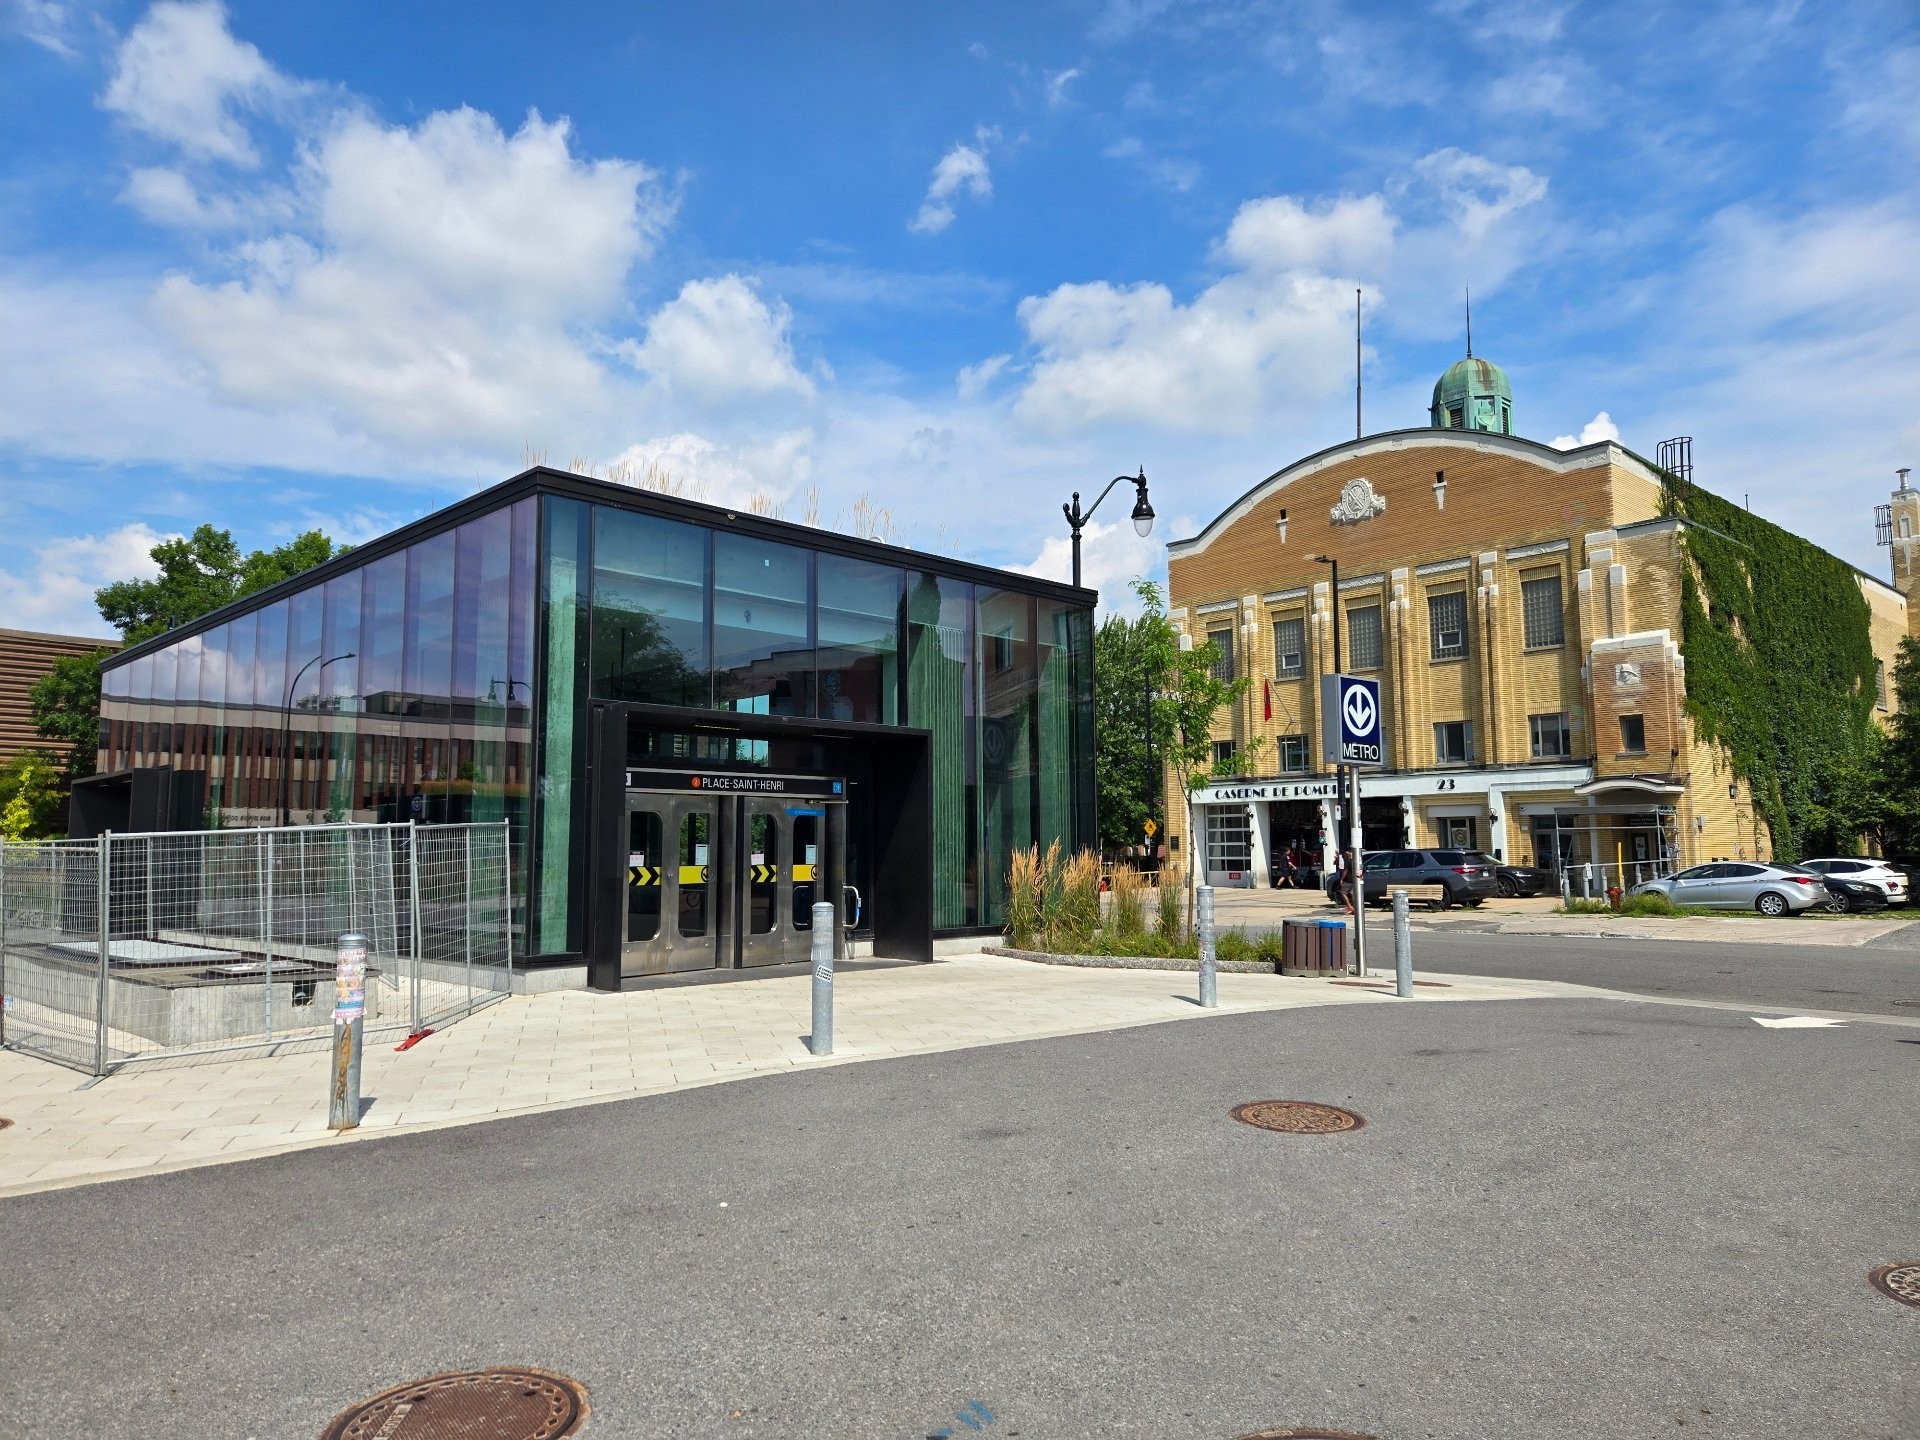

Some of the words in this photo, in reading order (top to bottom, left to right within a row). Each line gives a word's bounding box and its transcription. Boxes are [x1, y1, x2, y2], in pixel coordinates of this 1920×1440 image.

[1343, 743, 1379, 760] METRO
[702, 777, 784, 791] PLACE-SAINT-HENRI
[1215, 786, 1268, 800] CASERNE
[1273, 786, 1290, 798] DE
[1294, 783, 1362, 796] POMPI
[1437, 778, 1455, 792] 23
